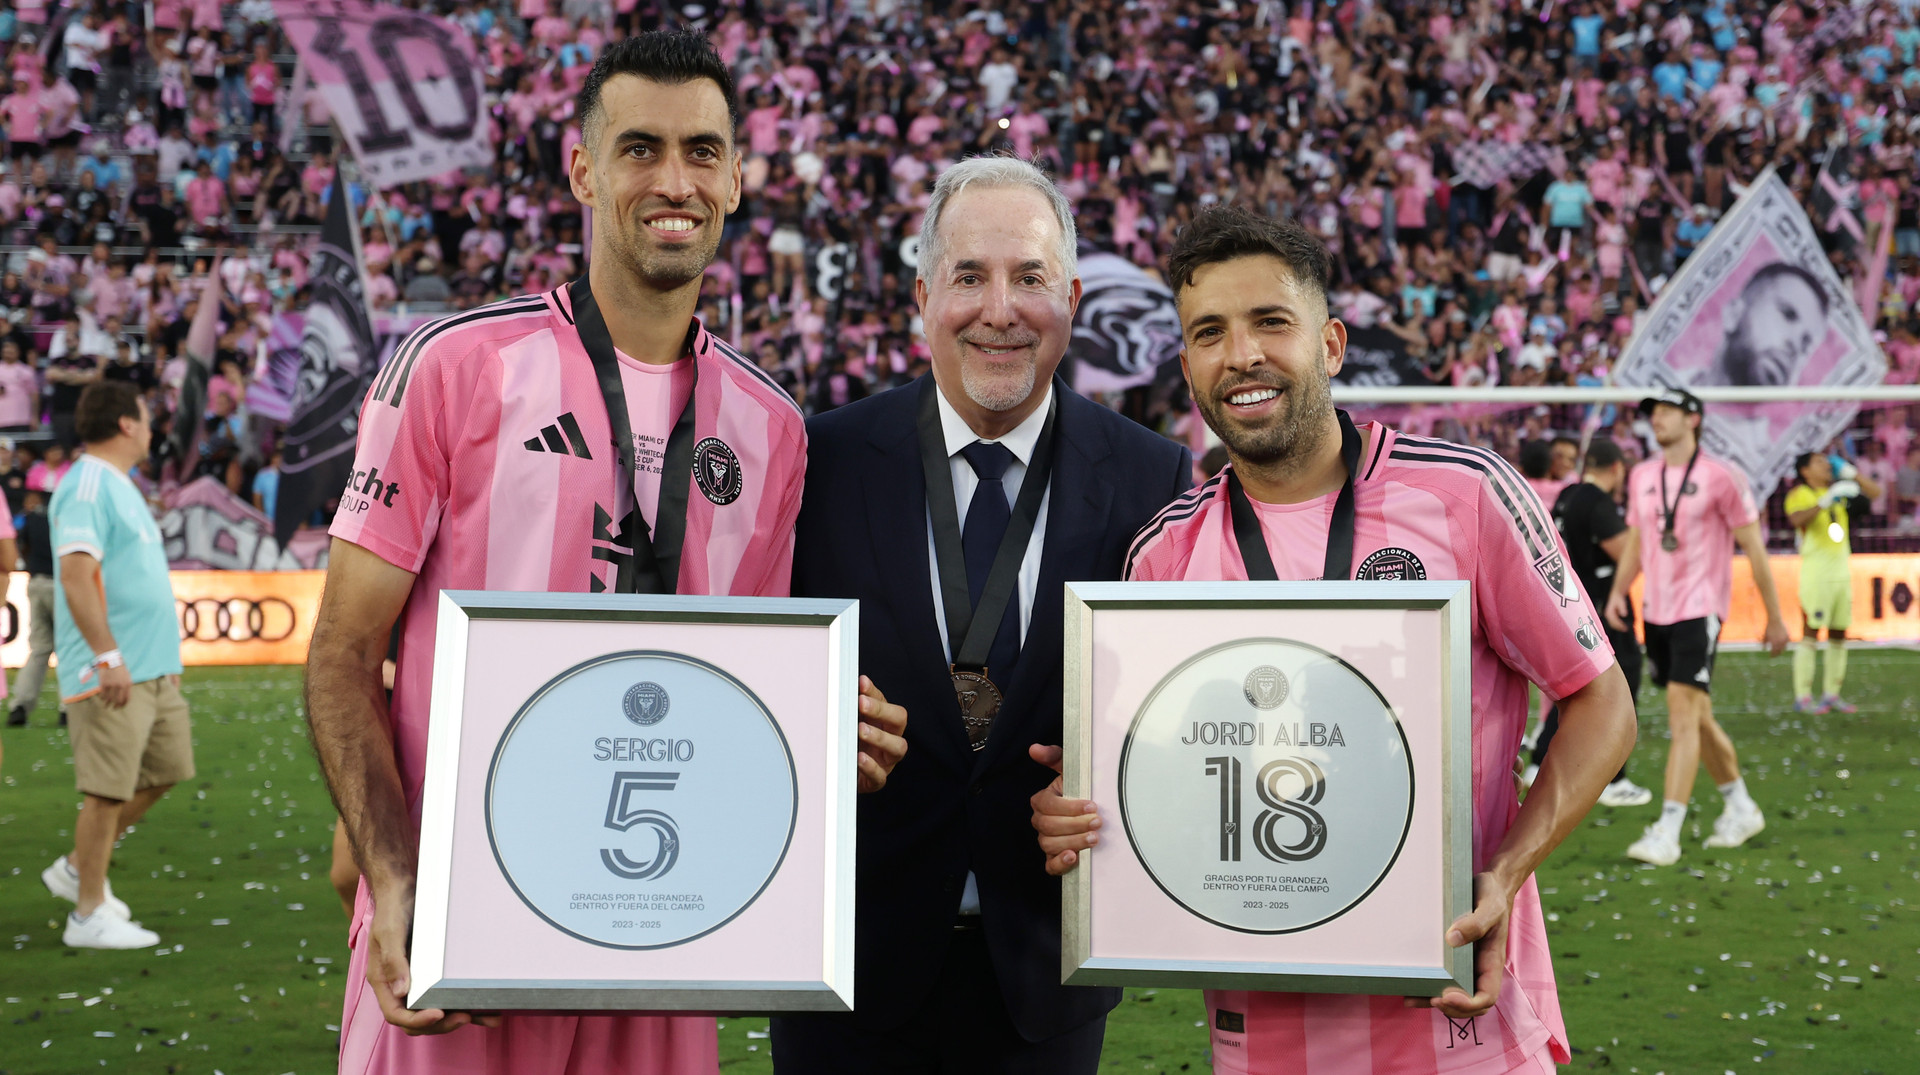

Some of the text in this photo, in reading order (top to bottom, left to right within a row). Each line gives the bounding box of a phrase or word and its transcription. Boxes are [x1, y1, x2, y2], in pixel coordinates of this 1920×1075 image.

[638, 434, 656, 444] MIAMI
[708, 452, 728, 464] MIAMI
[346, 466, 400, 508] acht
[340, 494, 369, 514] ROUP
[1412, 558, 1420, 568] DE
[1542, 557, 1562, 576] MLS
[1376, 564, 1403, 573] MIAMI
[1182, 722, 1346, 747] JORDI ALBA
[594, 737, 694, 762] SERGIO
[1205, 756, 1328, 864] 18
[600, 771, 680, 882] 5
[1204, 874, 1244, 882] GRACIAS
[1245, 875, 1264, 883] POR
[1278, 876, 1328, 884] GRANDEZA
[1203, 883, 1239, 891] DENTRO
[1248, 884, 1277, 892] FUERA
[1297, 885, 1330, 893] CAMPO
[572, 893, 704, 902] GRACIAS POR TU GRANDEZA
[570, 902, 608, 910] DENTRO
[610, 902, 617, 910] Y
[670, 903, 705, 911] CAMPO
[1243, 901, 1263, 909] 2023
[1269, 902, 1289, 910] 2025
[640, 921, 661, 929] 2025
